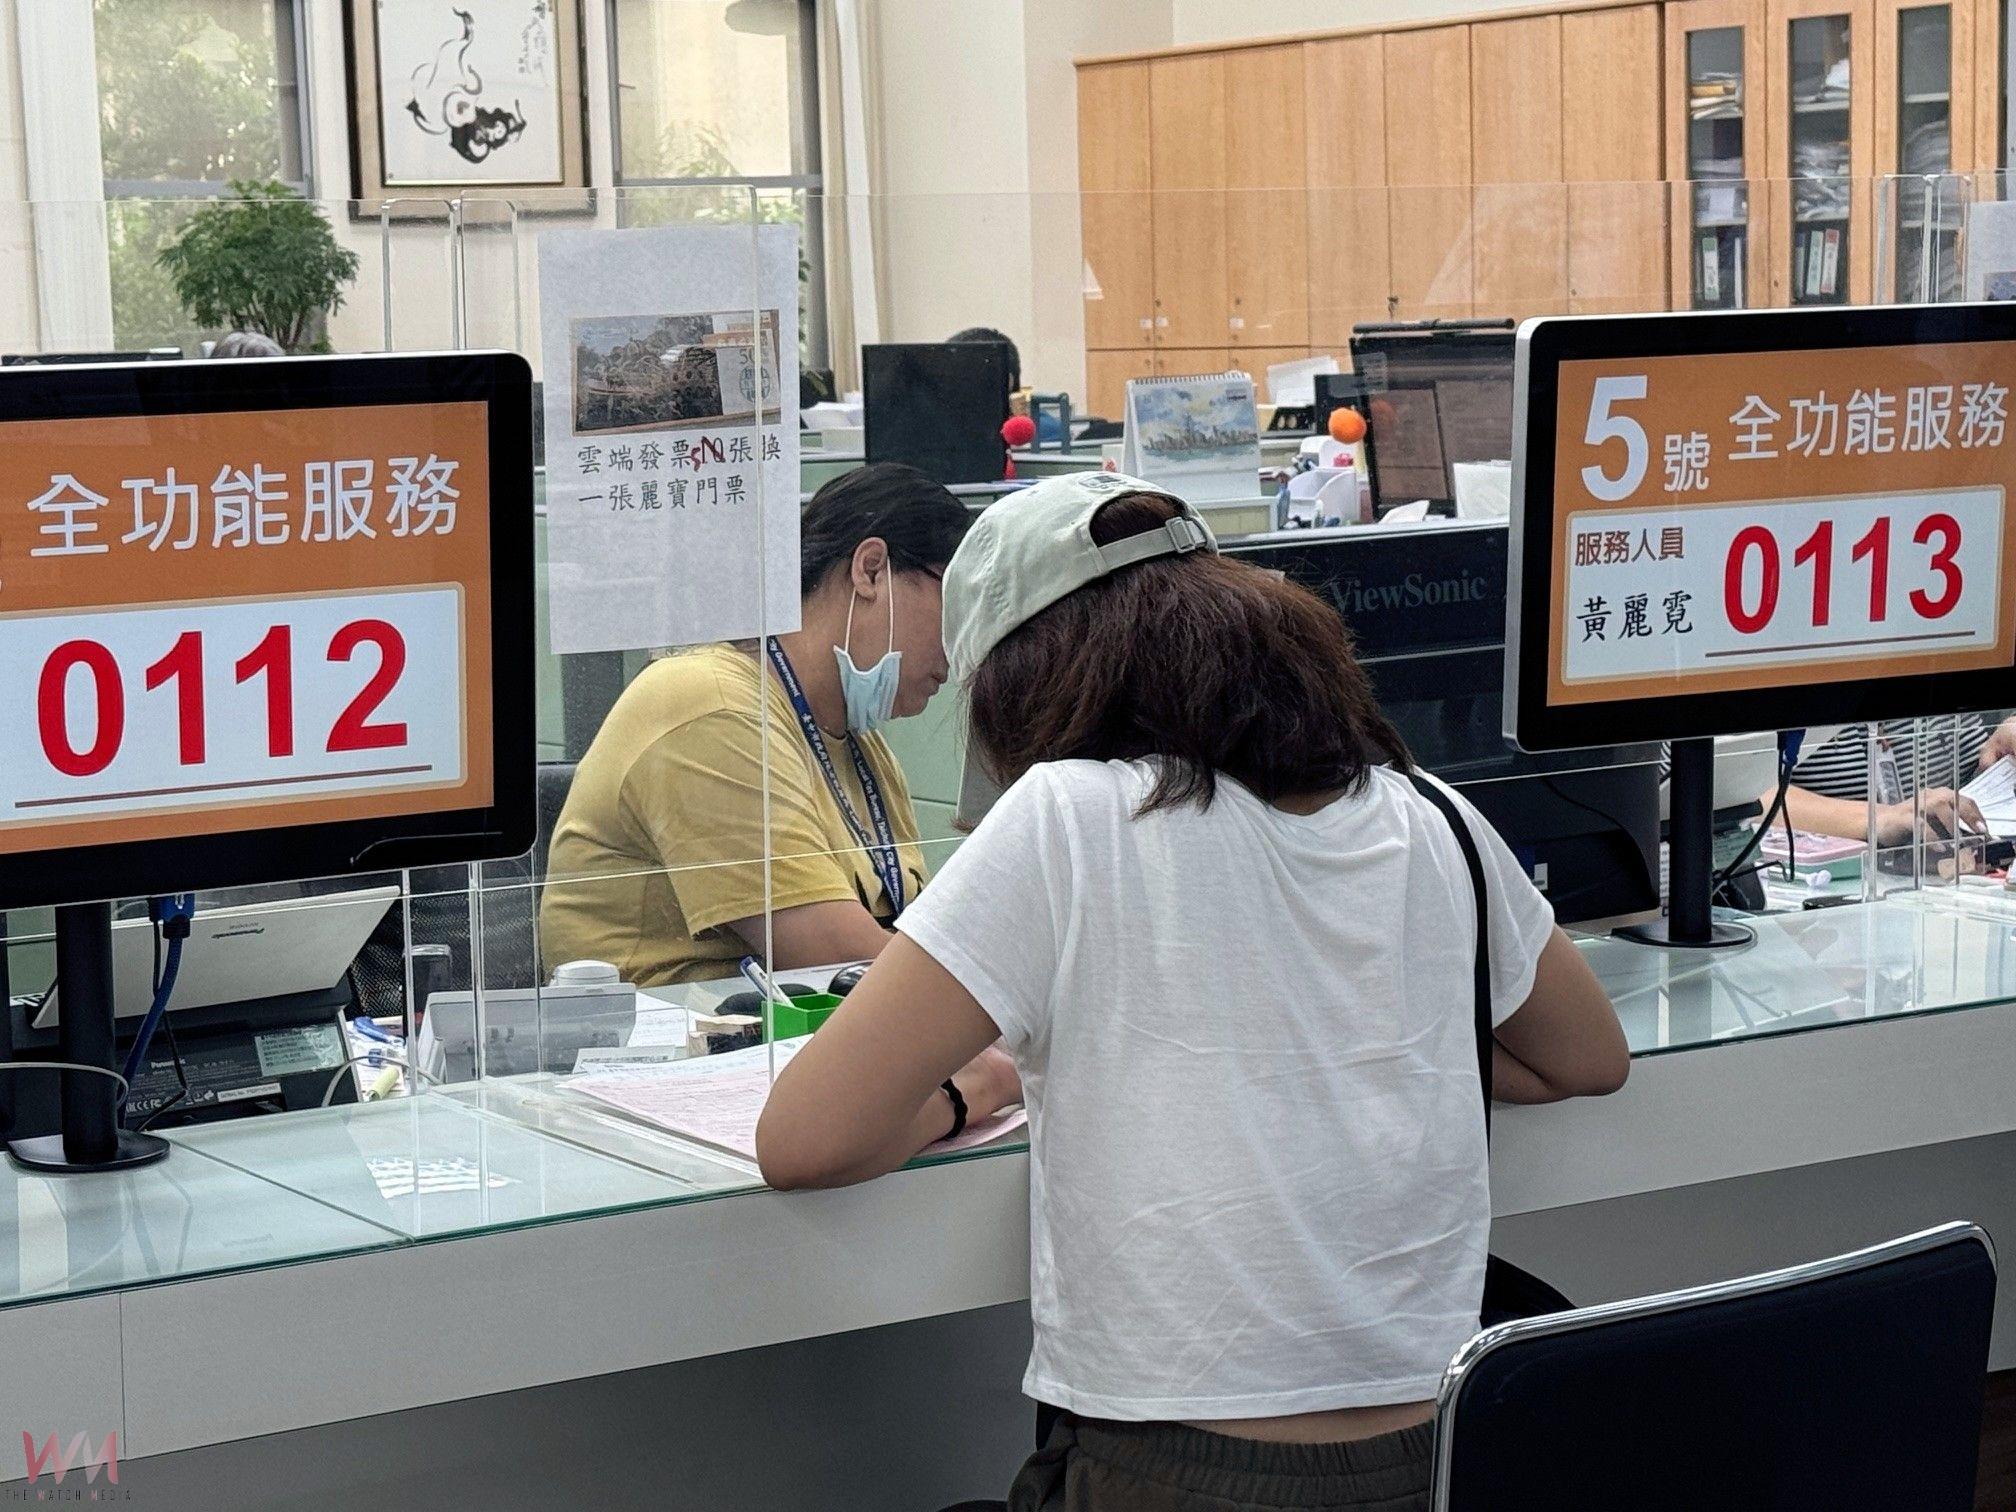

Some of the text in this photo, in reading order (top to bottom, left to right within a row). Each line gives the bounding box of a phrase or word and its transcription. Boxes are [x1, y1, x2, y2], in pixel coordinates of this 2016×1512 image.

[1728, 381, 2010, 460] 全功能服務
[27, 453, 461, 558] 全功能服務
[578, 474, 746, 512] 一張麗寶門票
[1575, 527, 1684, 566] 服務人員
[1724, 512, 1964, 635] 0113
[1329, 568, 1488, 612] ViewSonic
[36, 618, 408, 777] 0112
